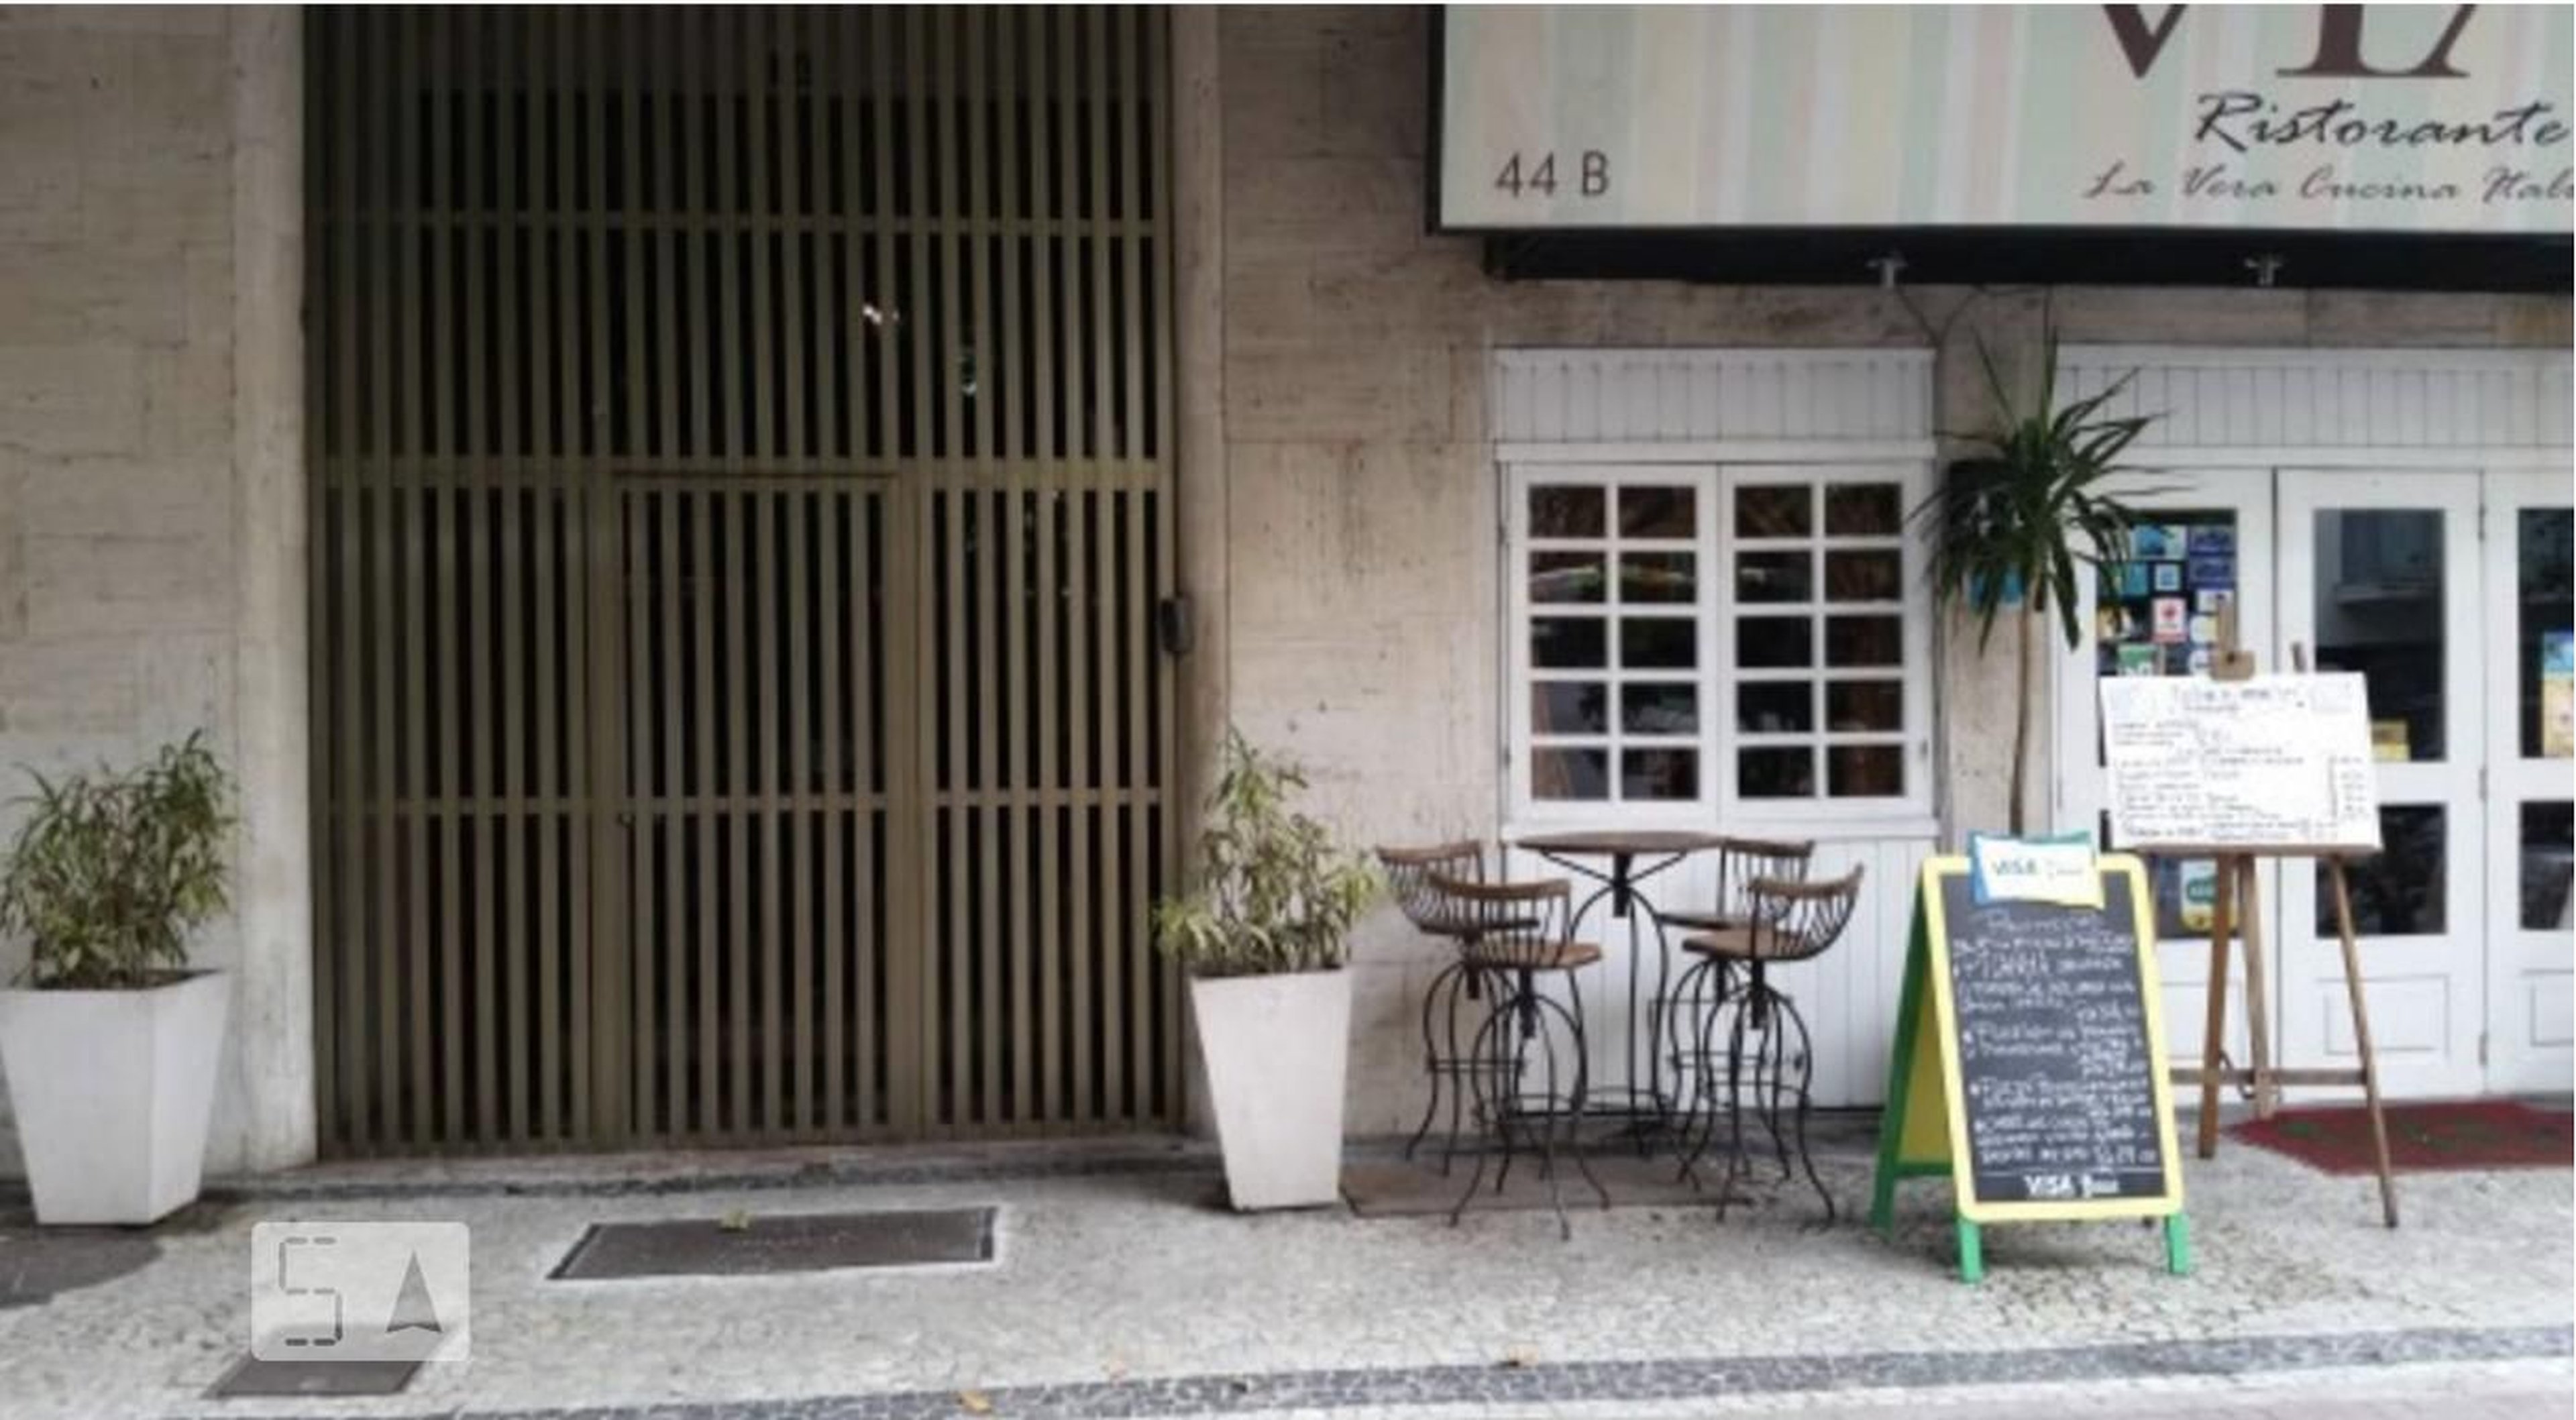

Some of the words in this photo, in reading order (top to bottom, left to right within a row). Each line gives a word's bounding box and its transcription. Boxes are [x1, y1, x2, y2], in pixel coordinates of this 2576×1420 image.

[2194, 91, 2571, 152] Ristorante
[1495, 150, 1557, 198] 44
[1581, 150, 1610, 197] B
[2084, 160, 2153, 199] La
[2183, 164, 2276, 198] Vera
